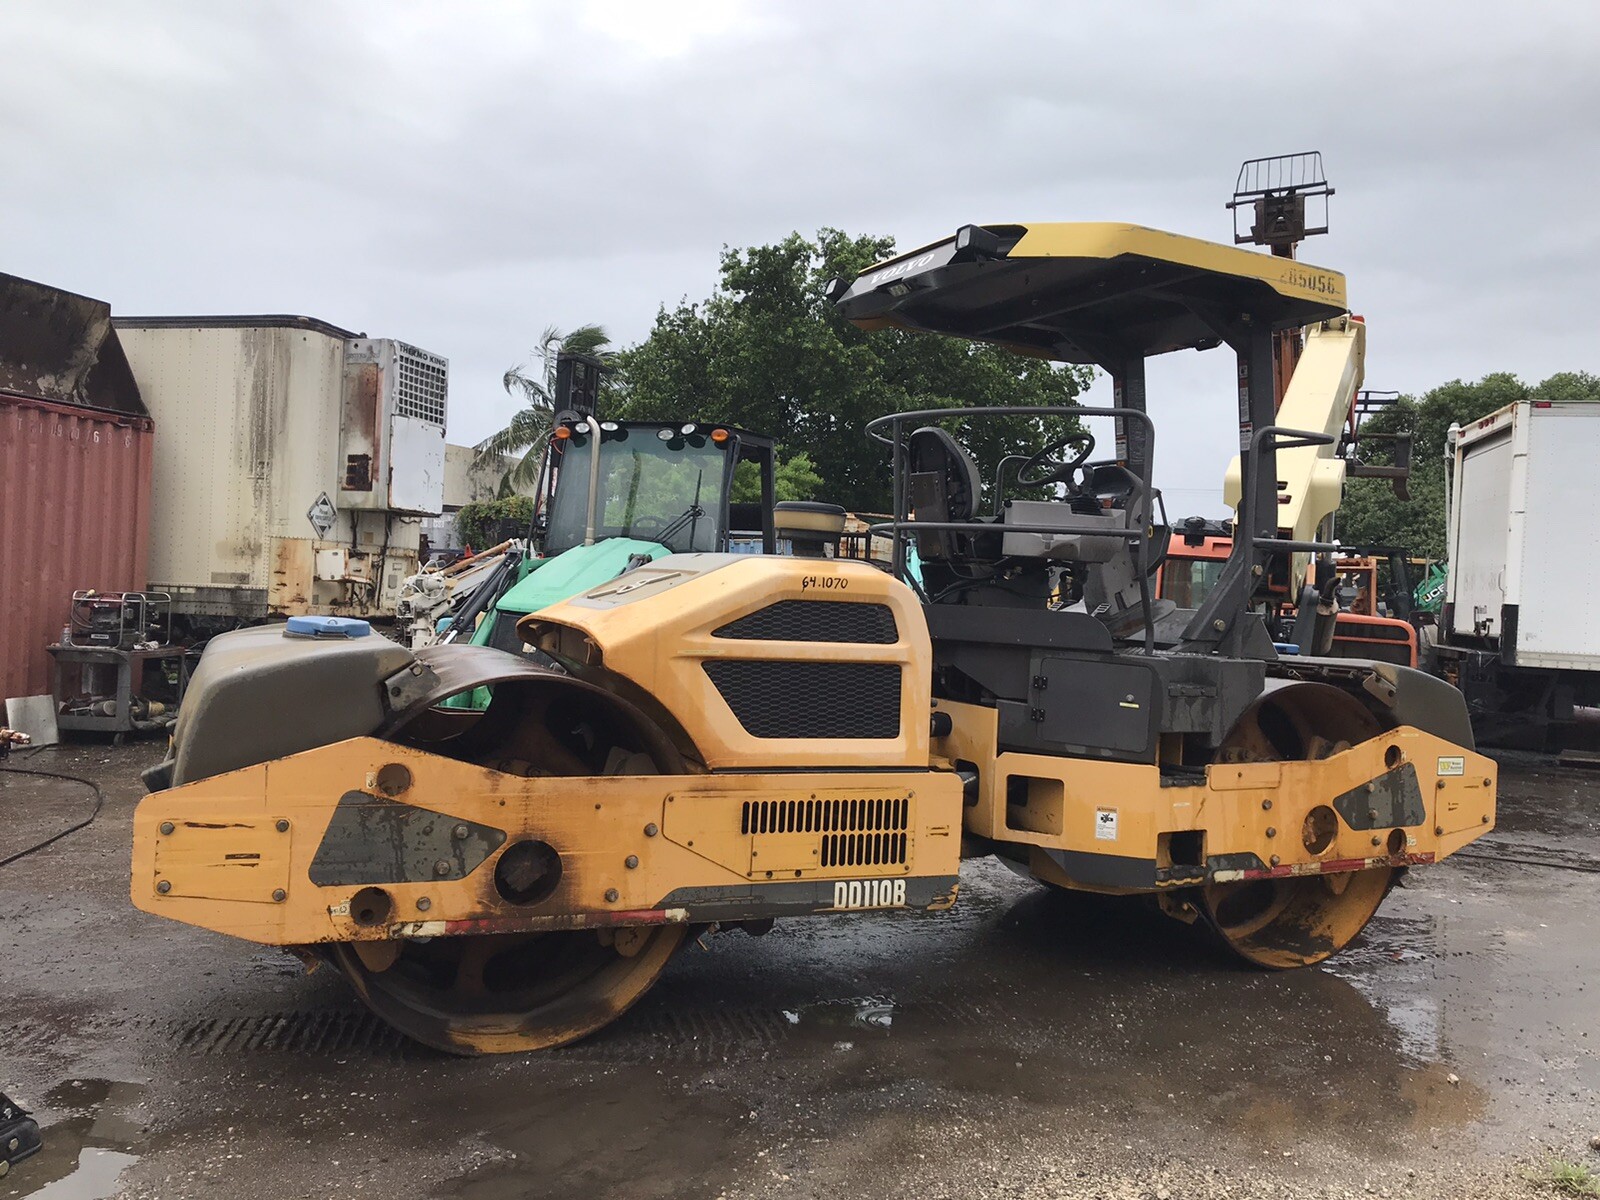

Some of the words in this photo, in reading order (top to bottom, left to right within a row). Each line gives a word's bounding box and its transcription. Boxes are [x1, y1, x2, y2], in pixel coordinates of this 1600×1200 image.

[871, 254, 935, 284] VOLVO
[399, 345, 428, 361] THERMO
[429, 355, 446, 368] KING
[834, 879, 906, 909] DD110B
